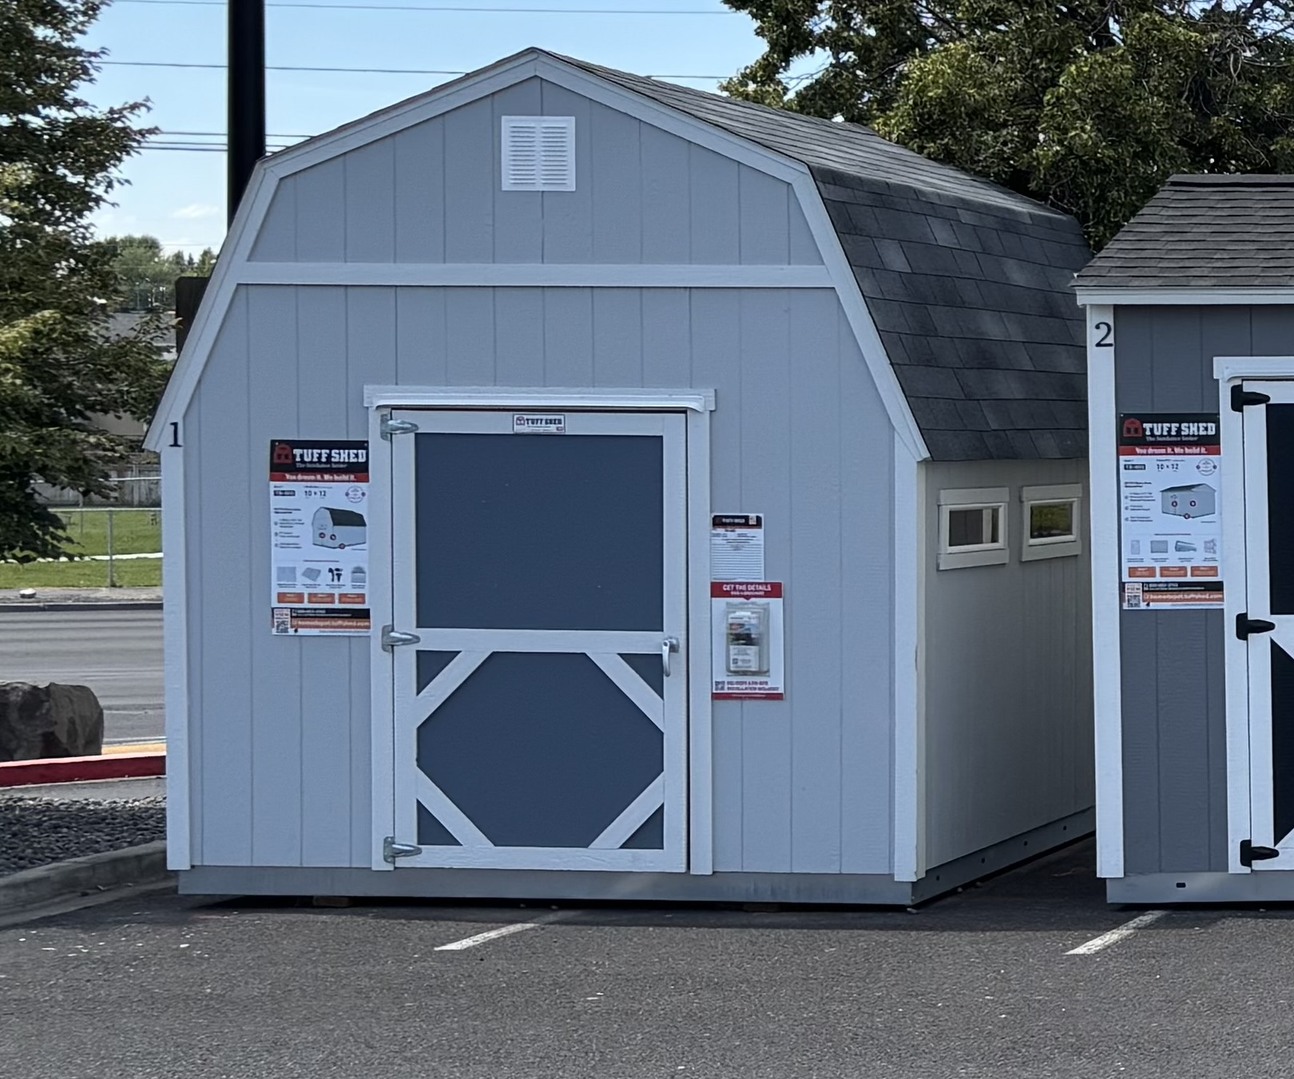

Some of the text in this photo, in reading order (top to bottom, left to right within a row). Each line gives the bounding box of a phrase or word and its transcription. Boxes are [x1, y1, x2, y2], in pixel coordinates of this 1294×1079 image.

[1095, 322, 1113, 347] 2
[169, 422, 183, 447] 1
[1143, 423, 1216, 435] TUFF SHED
[293, 449, 367, 462] TUFF SHED
